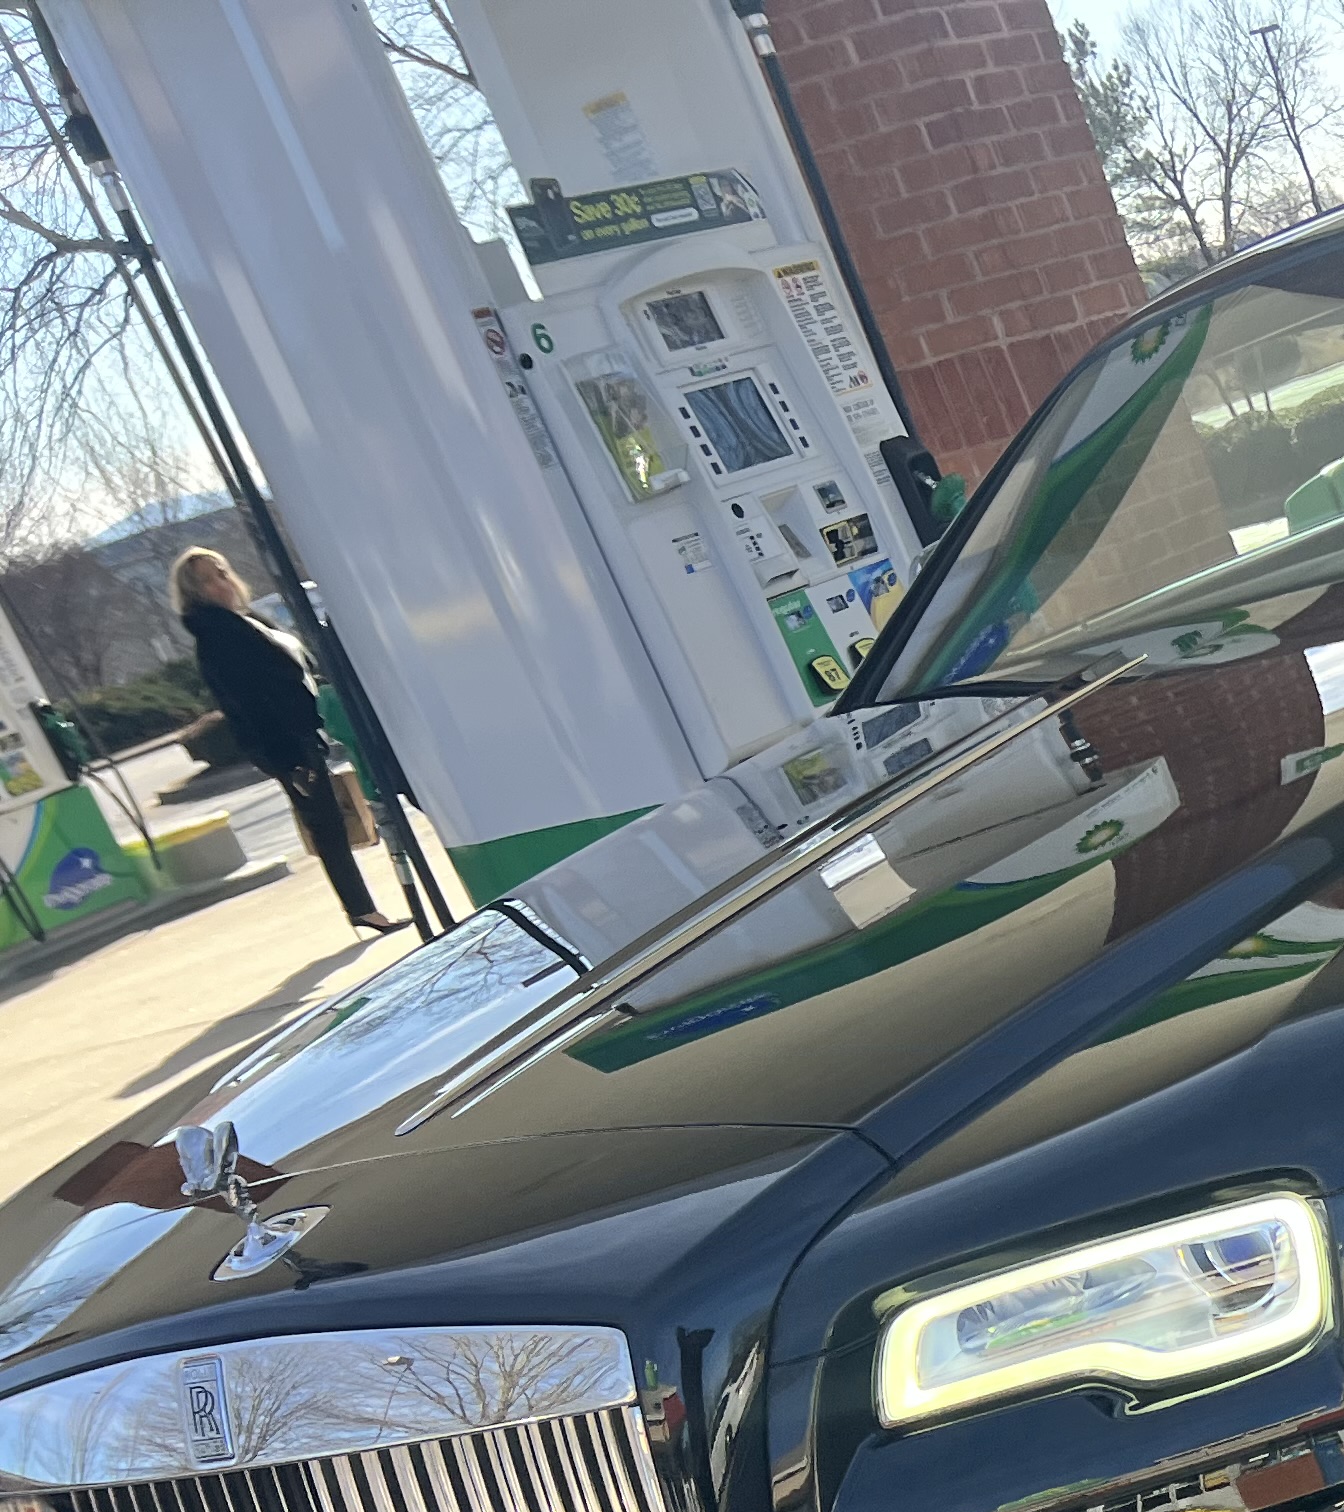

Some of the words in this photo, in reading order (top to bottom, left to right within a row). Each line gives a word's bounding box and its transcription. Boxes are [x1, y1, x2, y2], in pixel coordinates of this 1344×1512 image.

[531, 323, 554, 354] 6
[825, 668, 841, 682] 87
[189, 1385, 220, 1437] RR
